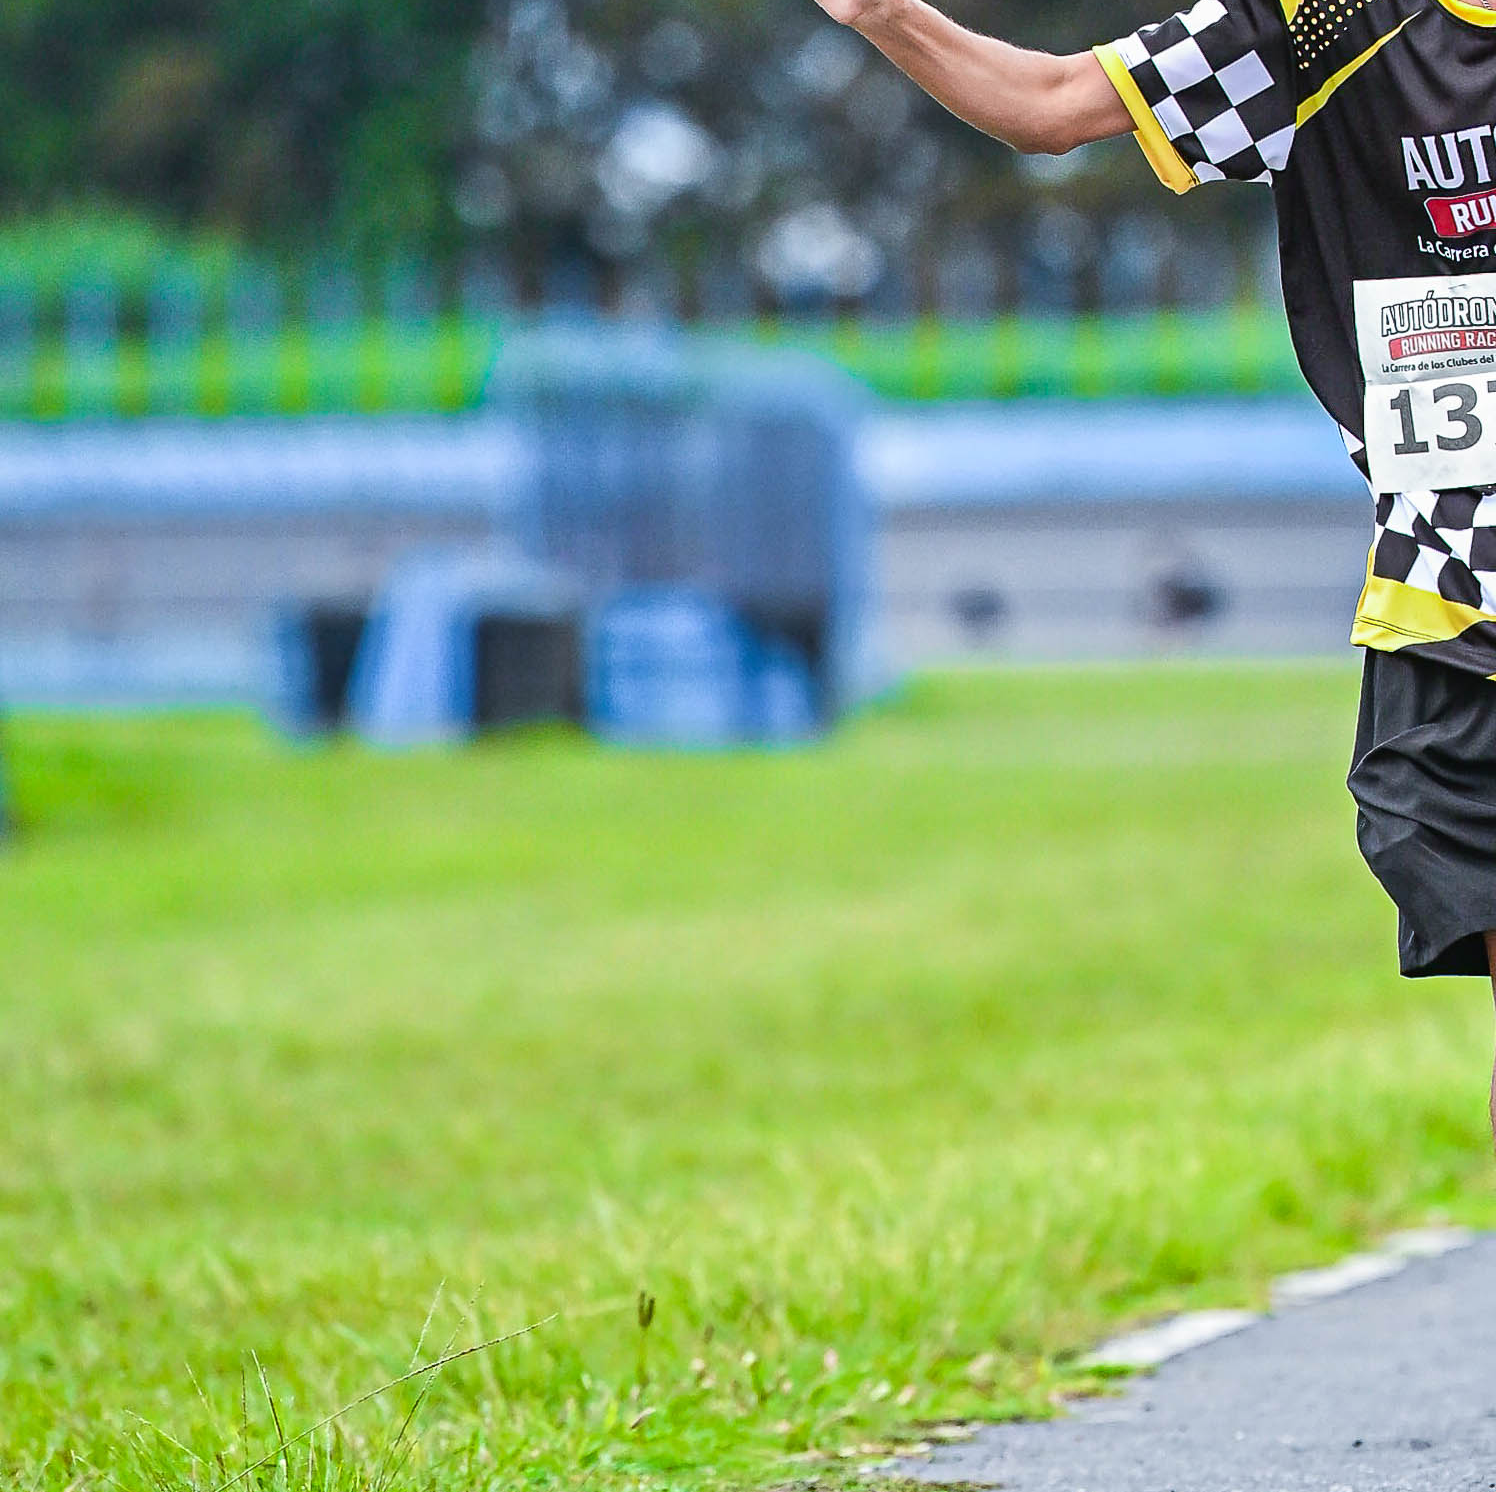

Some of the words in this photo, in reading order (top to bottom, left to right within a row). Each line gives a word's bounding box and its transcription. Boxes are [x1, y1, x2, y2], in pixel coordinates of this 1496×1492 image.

[1417, 235, 1435, 254] La
[1435, 240, 1489, 262] Carrera
[1401, 332, 1461, 356] RUNNING
[1381, 363, 1390, 373] La
[1390, 364, 1416, 373] Carrera
[1417, 361, 1429, 371] de
[1431, 360, 1446, 369] los
[1446, 356, 1478, 368] Clubes
[1480, 354, 1495, 364] del
